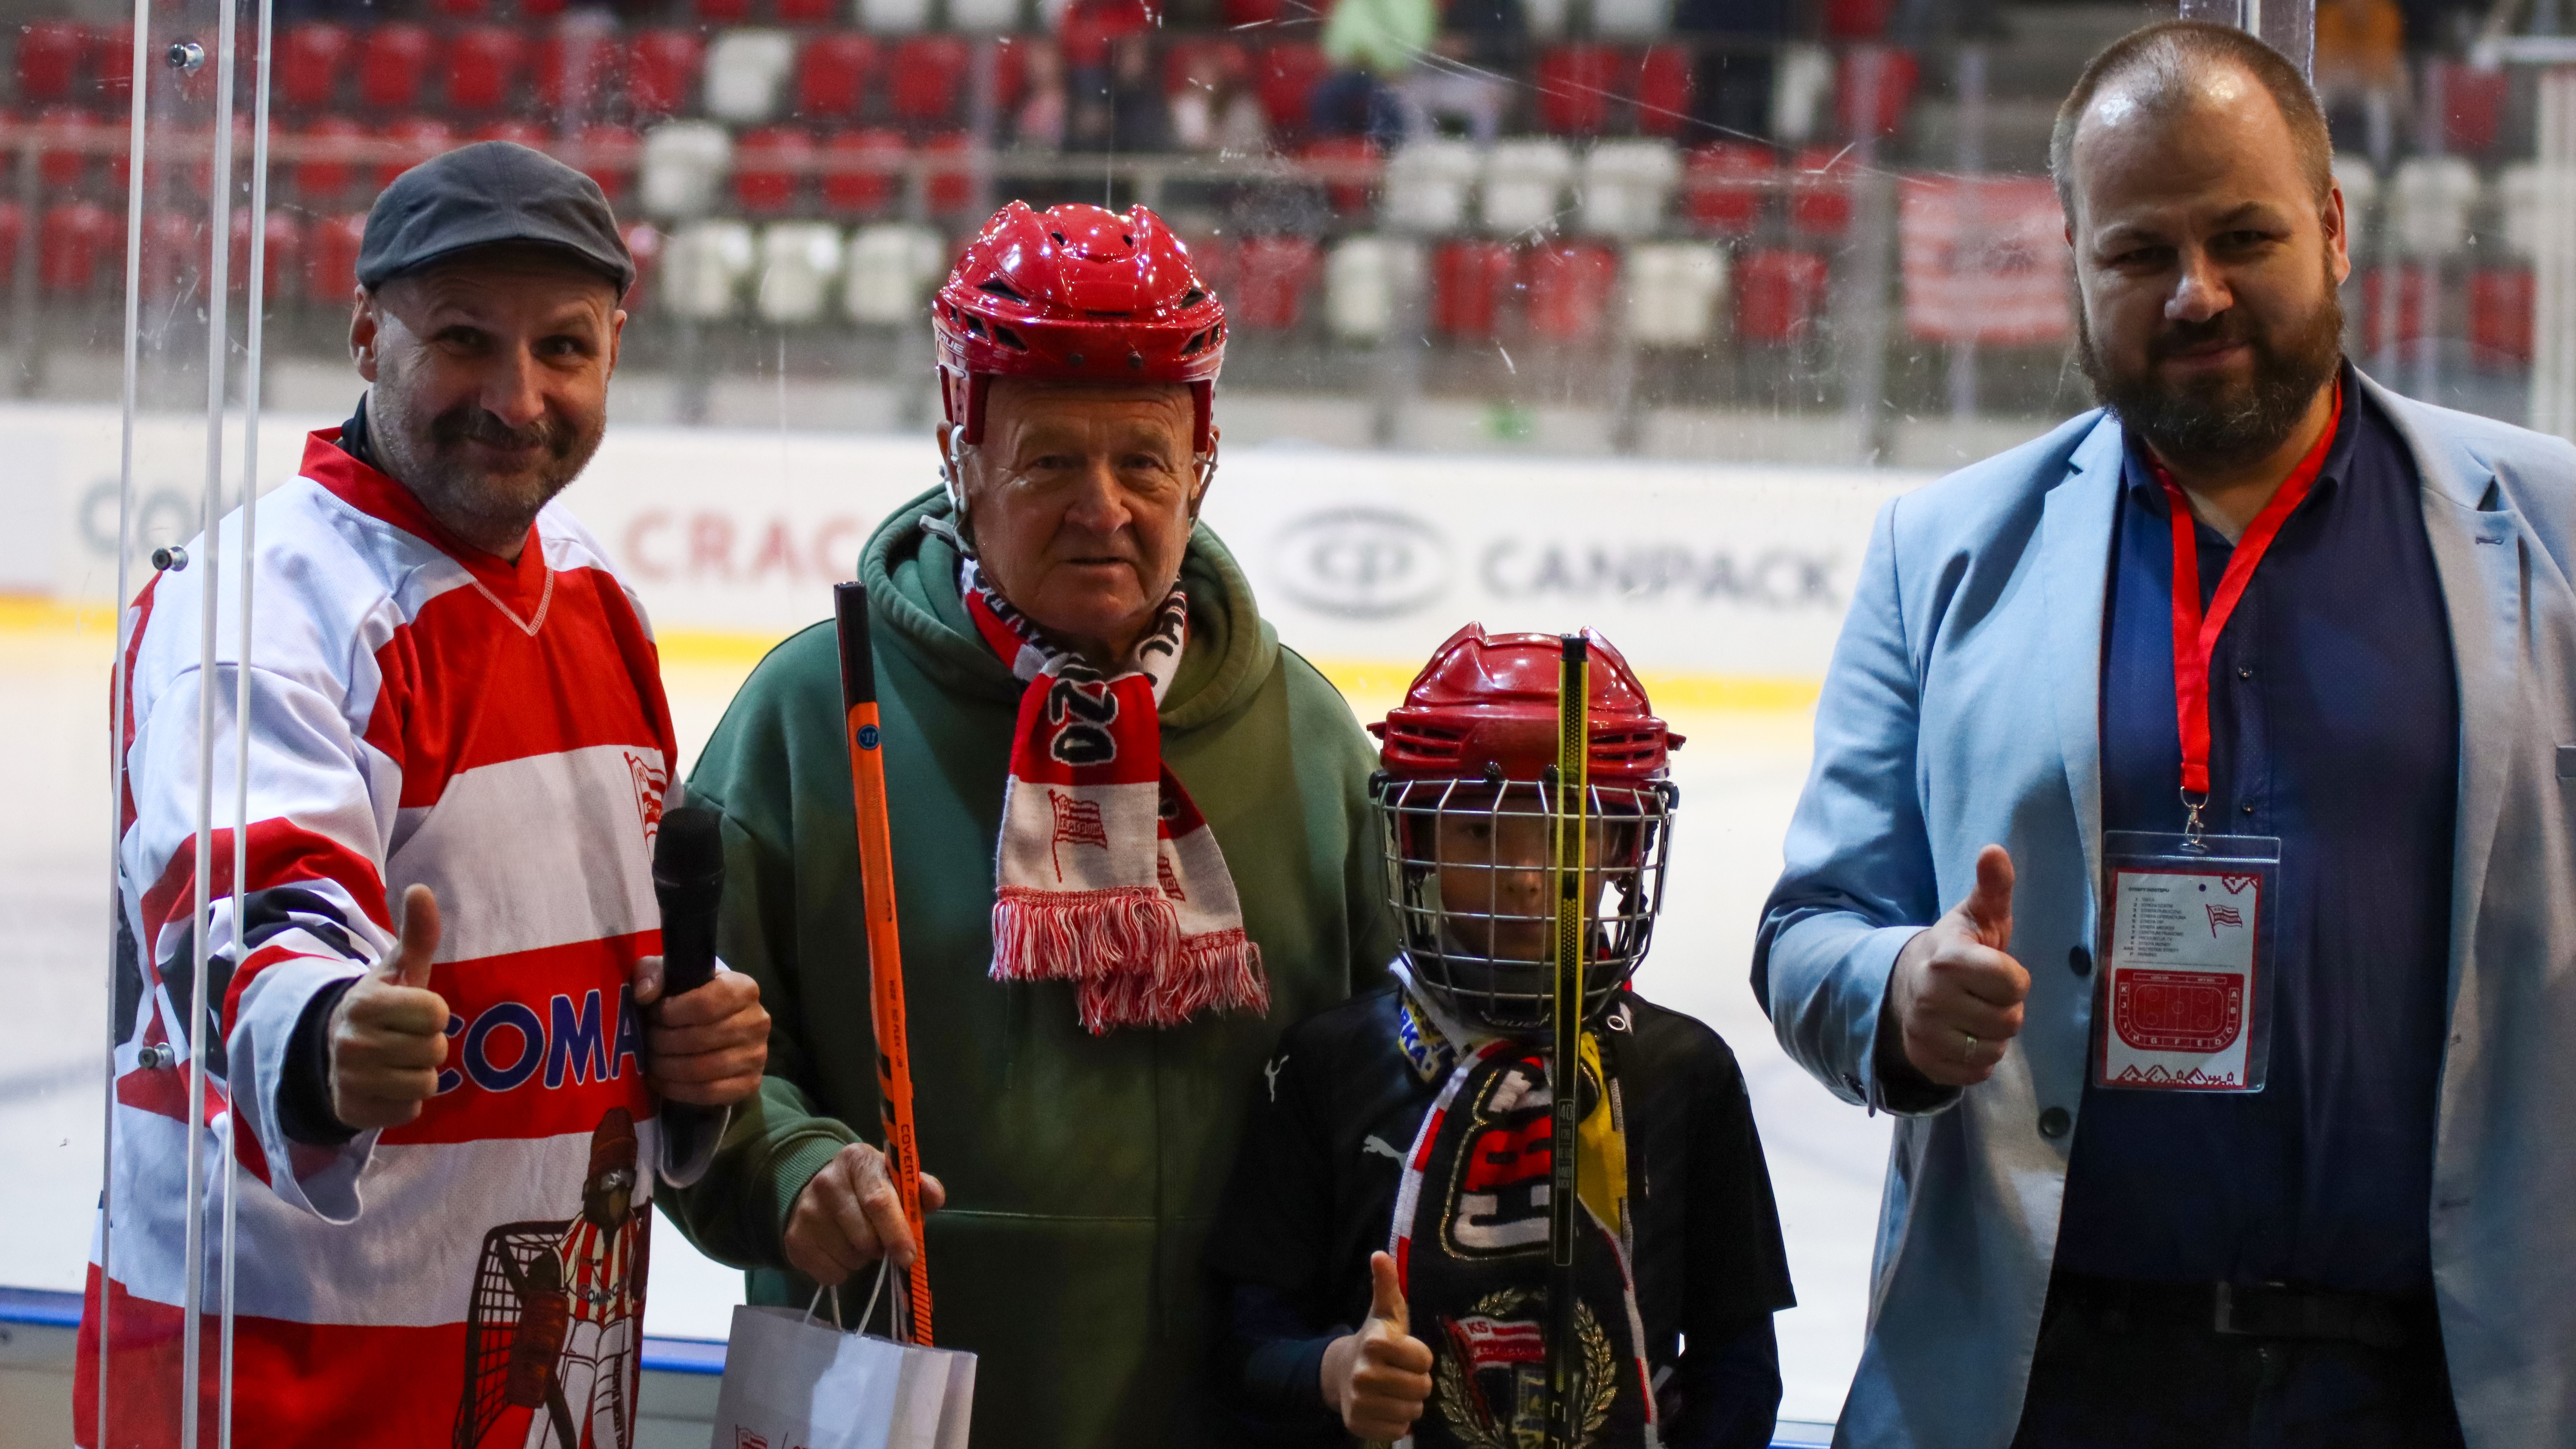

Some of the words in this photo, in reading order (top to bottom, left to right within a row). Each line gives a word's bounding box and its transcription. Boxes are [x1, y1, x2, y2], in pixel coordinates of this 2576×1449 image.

[1480, 536, 1842, 611] CANPACK
[1560, 1104, 1573, 1121] 40
[901, 1124, 915, 1183] COVERT
[1467, 1321, 1489, 1334] KS
